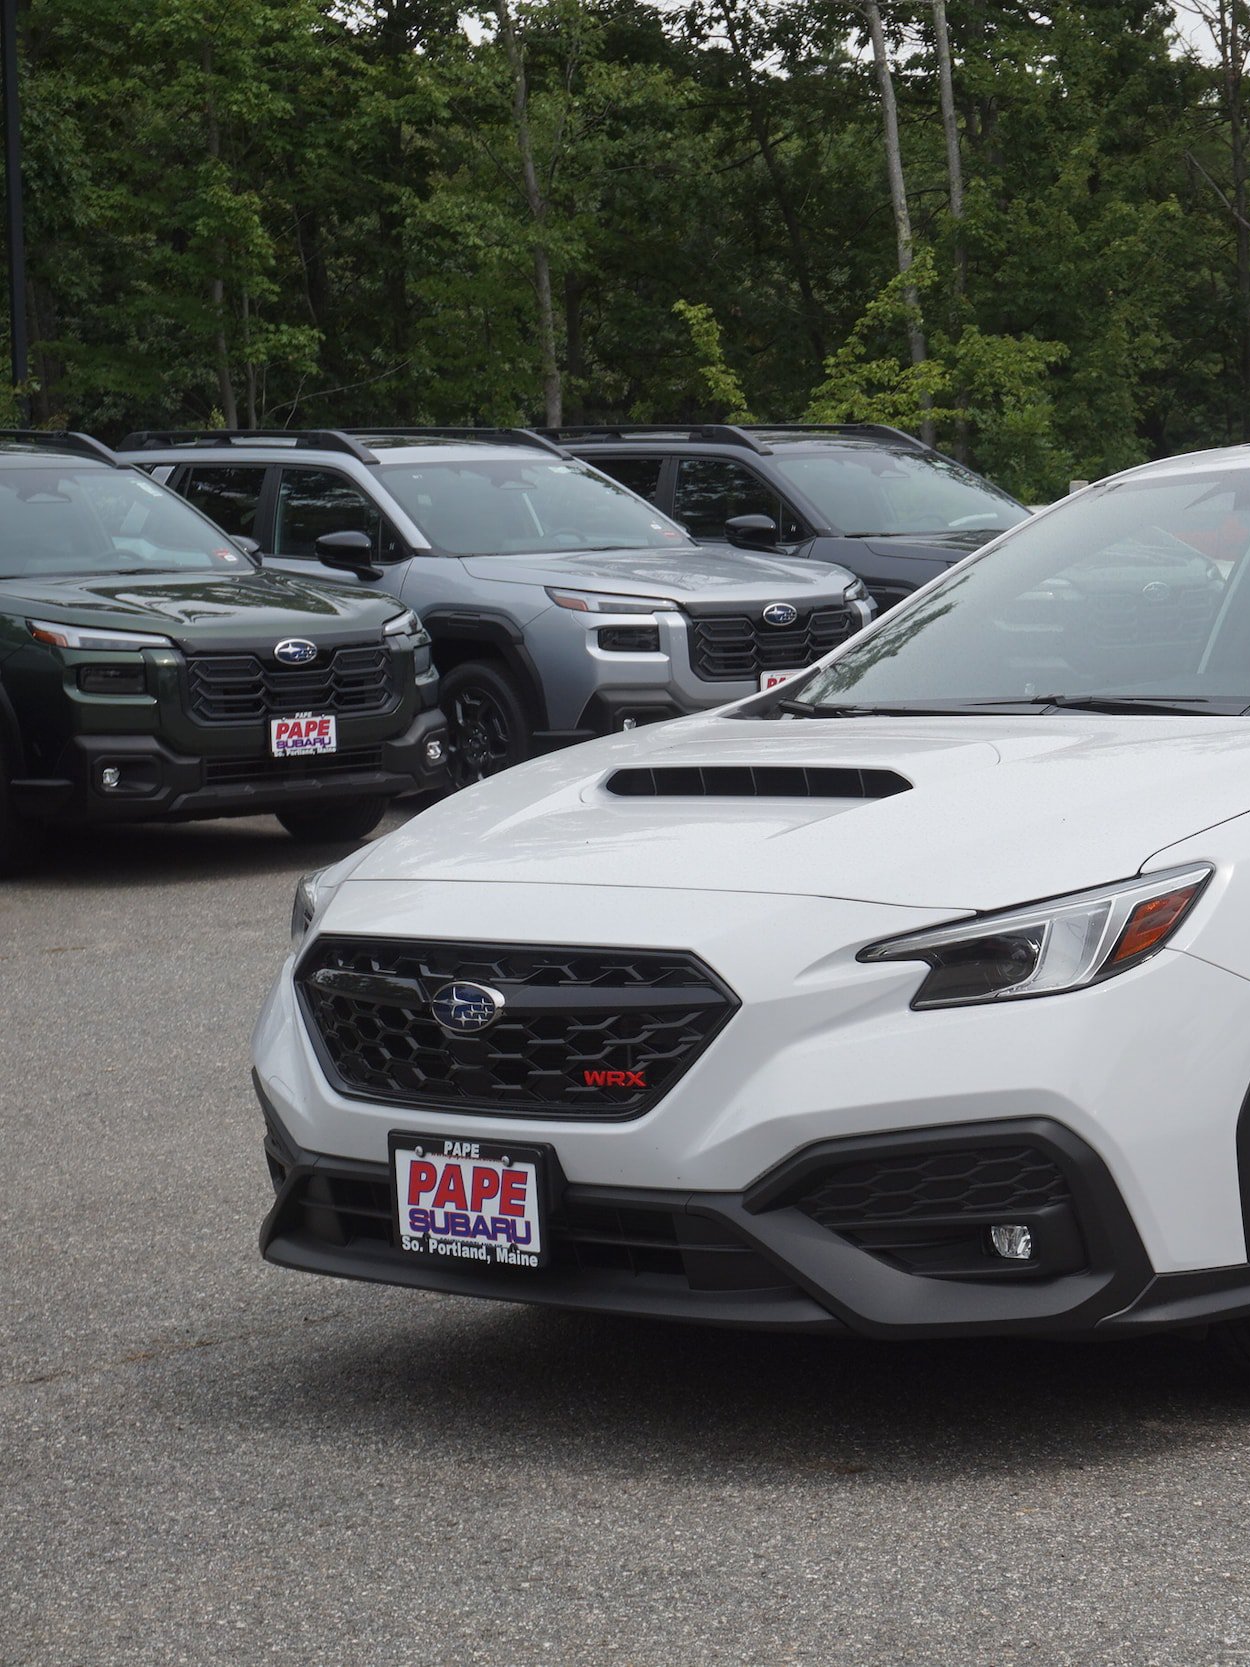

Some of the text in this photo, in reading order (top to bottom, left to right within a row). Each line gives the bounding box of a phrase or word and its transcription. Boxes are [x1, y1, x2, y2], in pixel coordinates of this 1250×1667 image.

[276, 719, 330, 739] PAPE
[276, 736, 331, 749] SUBARU
[583, 1070, 647, 1087] WRX
[443, 1140, 480, 1158] PAPE
[407, 1160, 528, 1218] PAPE
[409, 1208, 532, 1245] SUBARU
[401, 1235, 424, 1252] So.
[429, 1238, 491, 1264] Portland,
[496, 1247, 538, 1268] Maine
